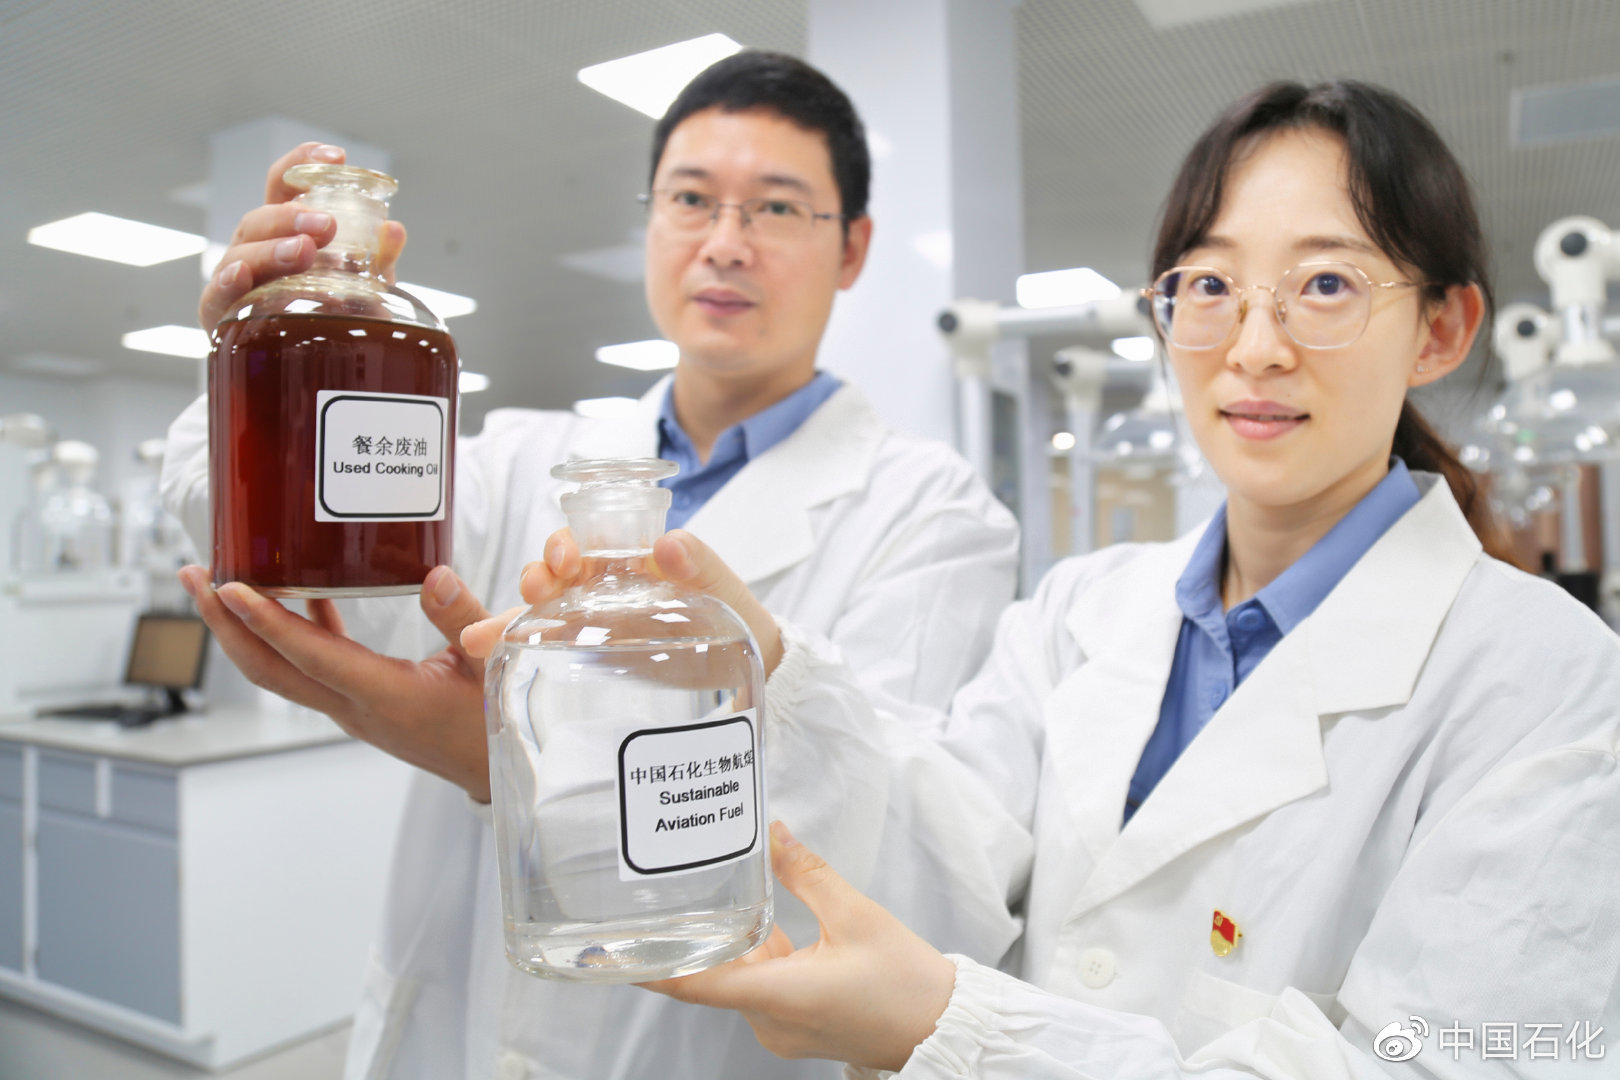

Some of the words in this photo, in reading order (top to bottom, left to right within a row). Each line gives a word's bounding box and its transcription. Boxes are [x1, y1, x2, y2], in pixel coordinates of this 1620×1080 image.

[352, 434, 427, 457] 餐余废油
[333, 461, 371, 474] Used
[375, 462, 424, 478] Cooking
[426, 463, 438, 475] Oil
[659, 780, 740, 806] Sustainable
[655, 812, 715, 833] Aviation
[719, 802, 744, 821] Fuel
